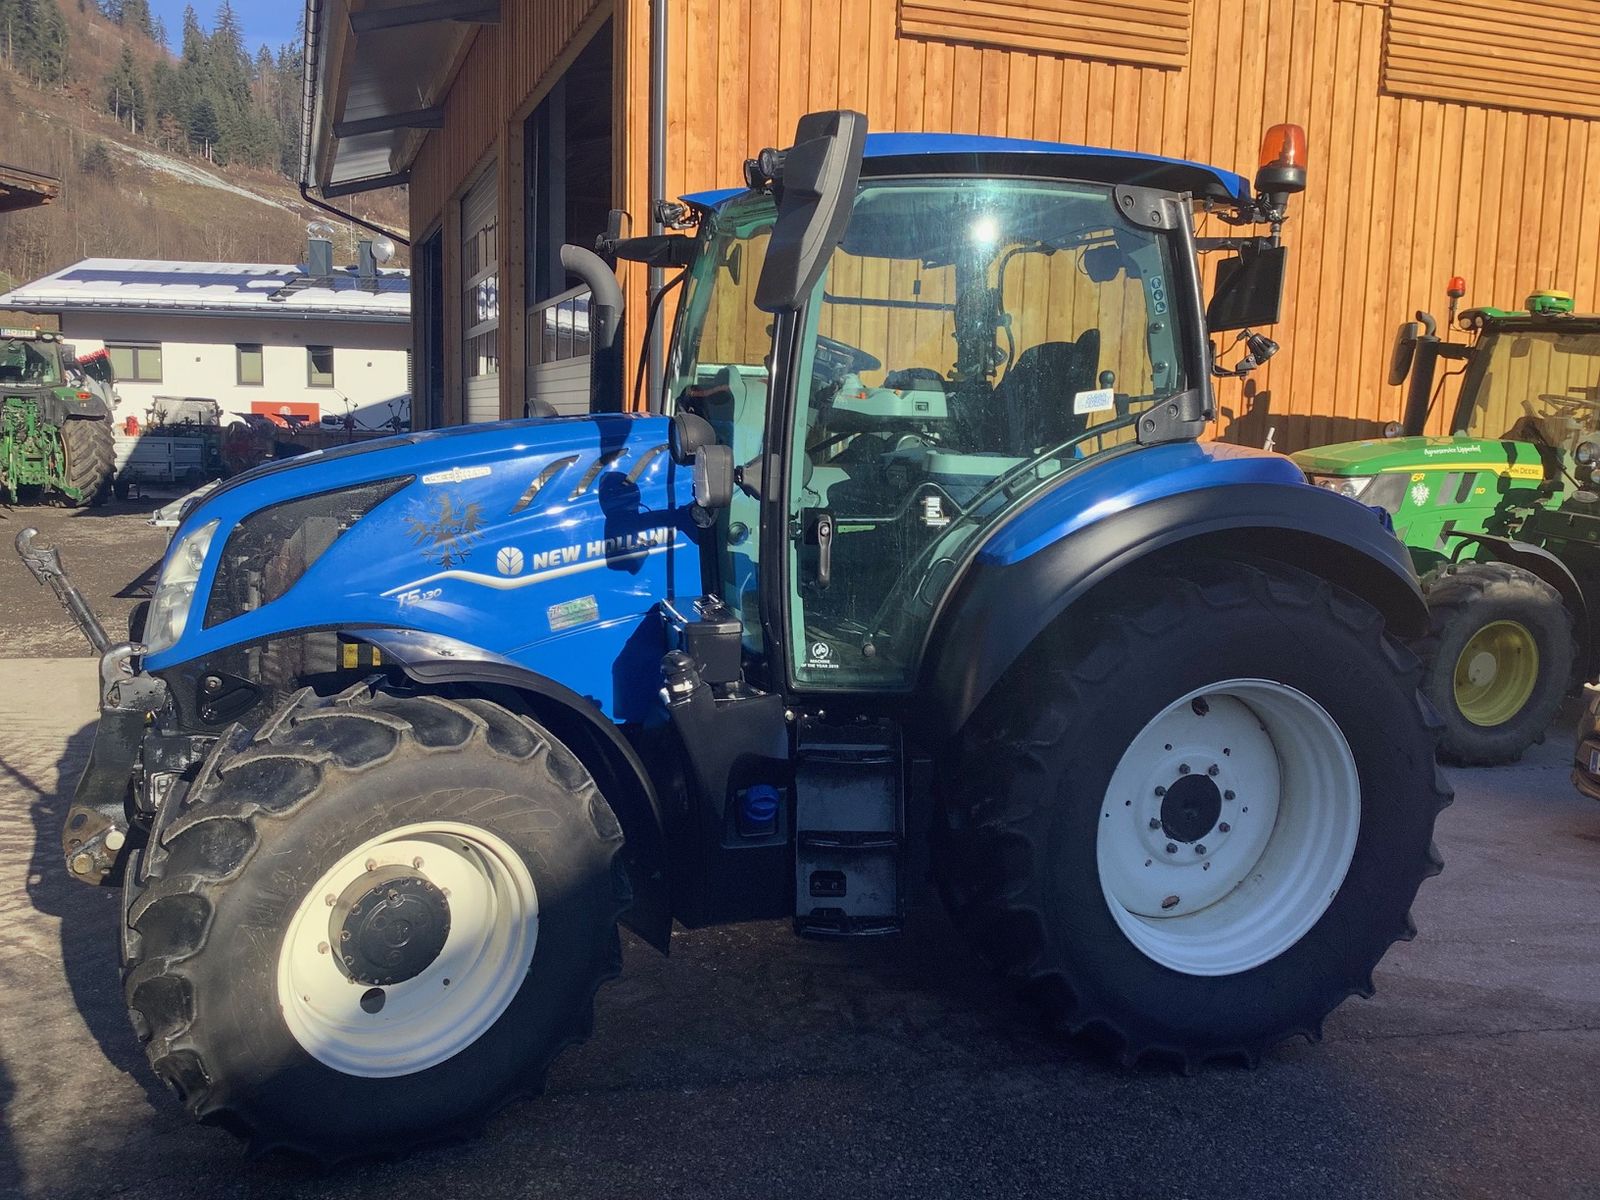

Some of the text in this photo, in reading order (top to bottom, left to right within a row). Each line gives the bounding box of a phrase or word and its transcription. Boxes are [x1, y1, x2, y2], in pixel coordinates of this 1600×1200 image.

[1520, 467, 1540, 475] DEERE
[533, 525, 678, 570] NEW HOLLAND
